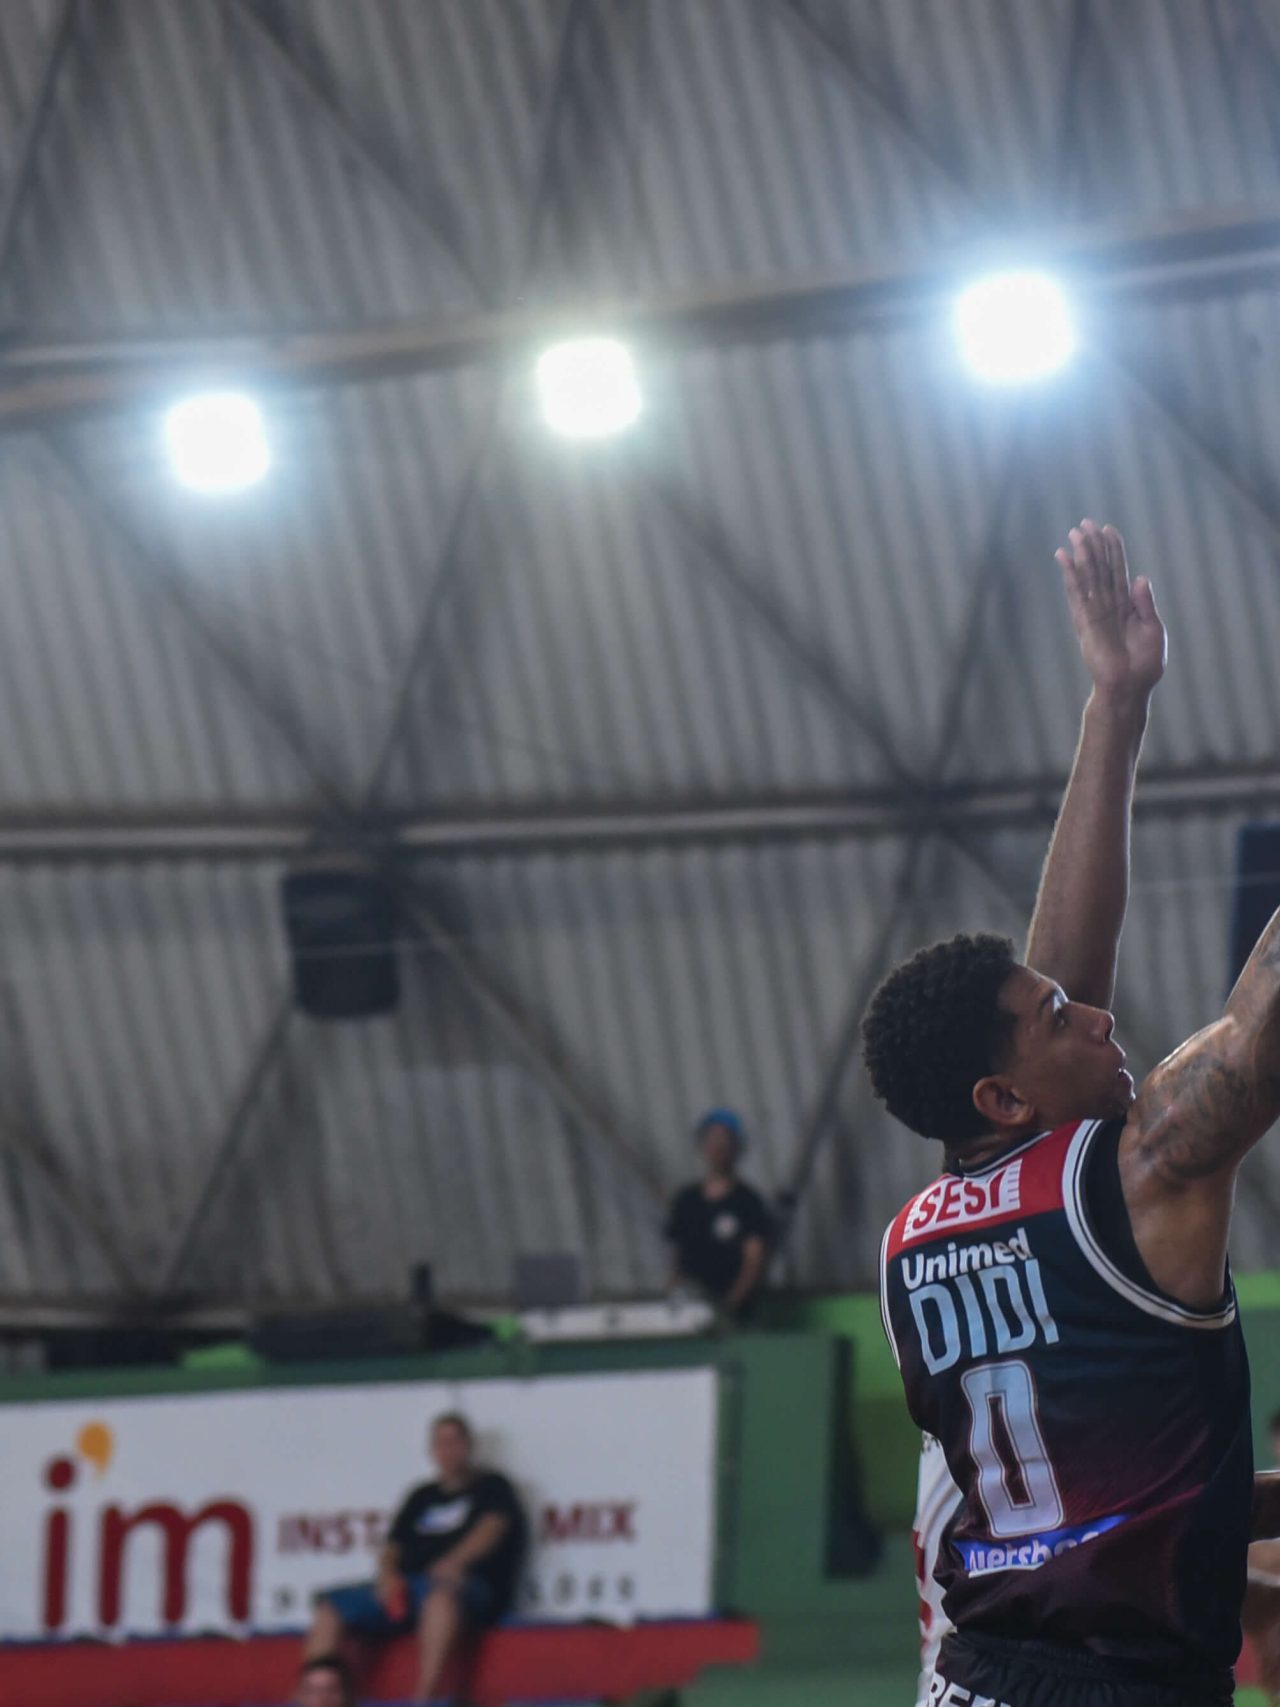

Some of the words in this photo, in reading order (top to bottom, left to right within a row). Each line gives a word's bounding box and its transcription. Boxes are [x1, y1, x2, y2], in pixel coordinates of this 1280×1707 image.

[901, 1227, 1034, 1291] Unimed
[908, 1258, 1060, 1377] DIDI
[960, 1359, 1065, 1539] 0
[542, 1501, 640, 1545] MIX
